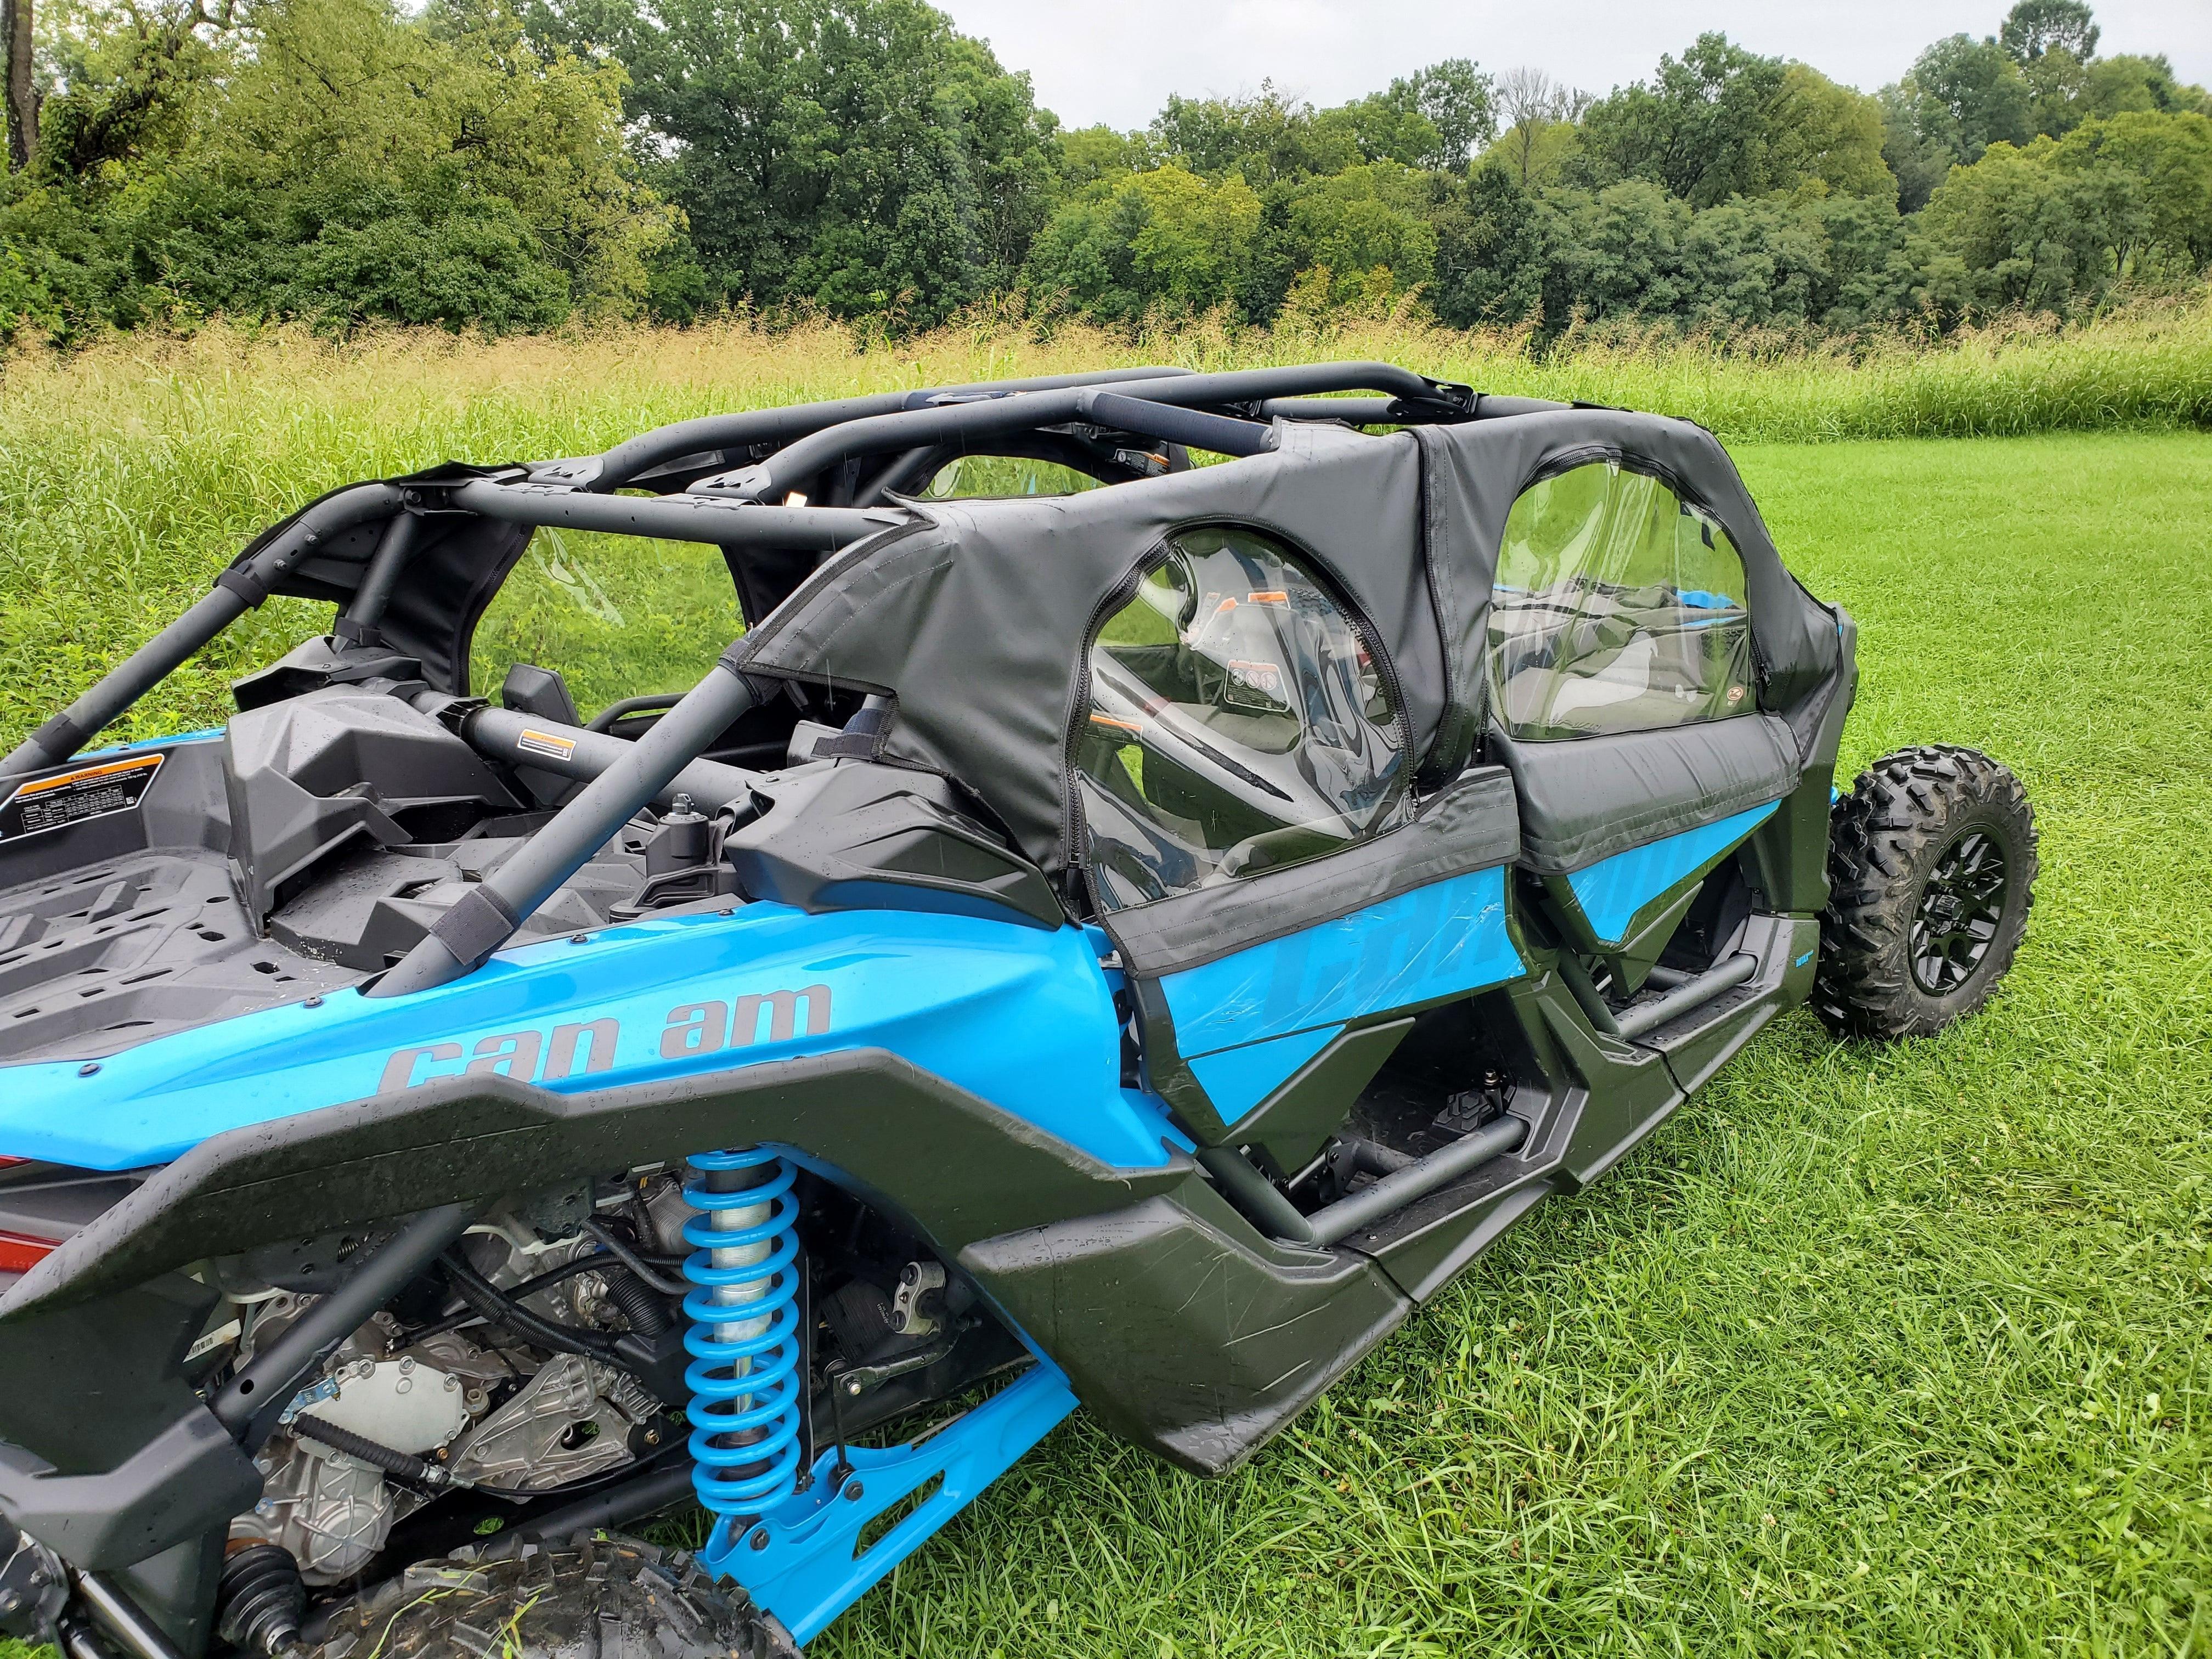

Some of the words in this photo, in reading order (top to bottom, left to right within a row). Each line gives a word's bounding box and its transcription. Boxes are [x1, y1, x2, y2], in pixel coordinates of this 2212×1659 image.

[75, 770, 103, 780] WARNING
[376, 1016, 620, 1096] can
[659, 984, 832, 1060] am
